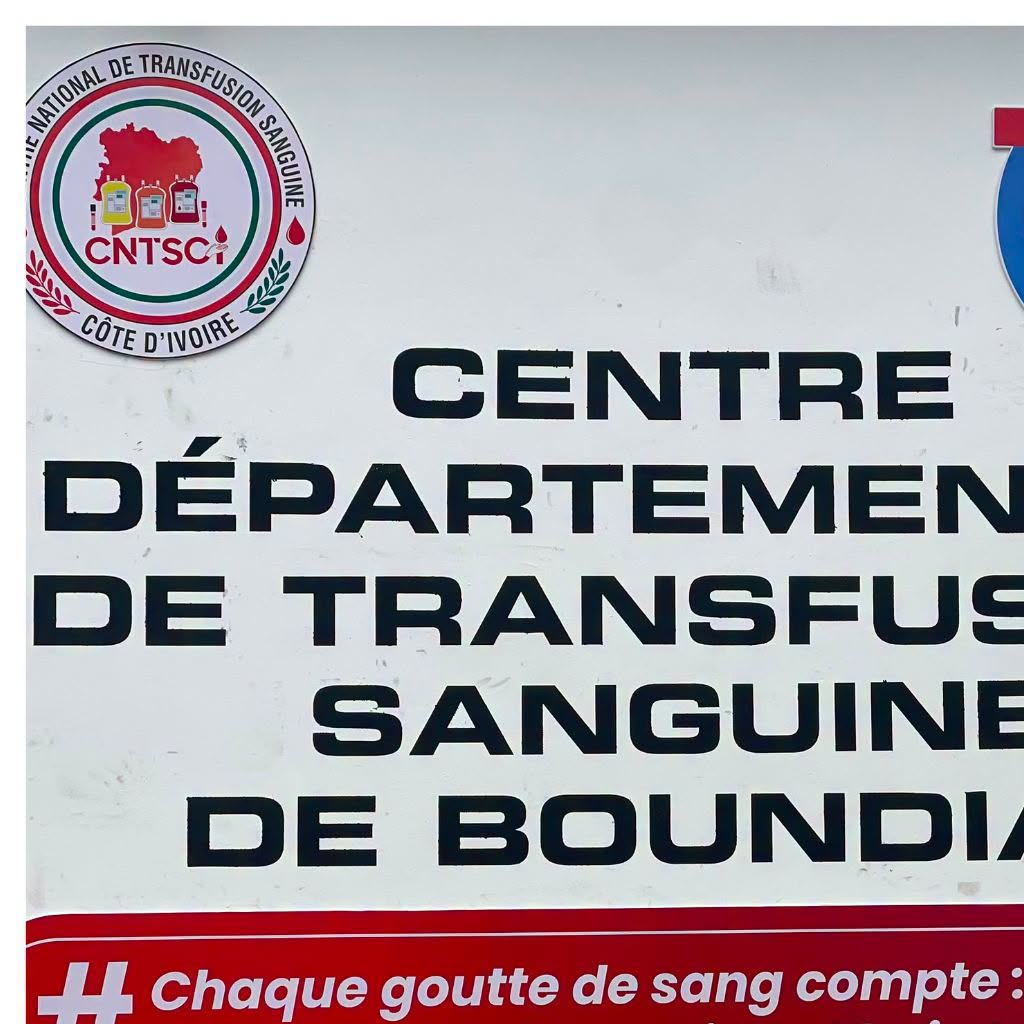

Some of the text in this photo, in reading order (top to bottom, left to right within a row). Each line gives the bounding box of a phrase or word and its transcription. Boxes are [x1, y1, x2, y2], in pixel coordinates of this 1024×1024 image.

[27, 54, 304, 208] NATIONAL DE TRANSFUSION SANGUINE
[81, 312, 239, 353] CÔTE D'IVOIRE
[393, 348, 953, 420] CENTRE
[34, 575, 226, 646] DE
[186, 796, 376, 867] DE
[152, 970, 367, 1022] Chaque
[380, 968, 559, 1021] goutte
[573, 965, 638, 1004] de
[651, 972, 783, 1016] sang
[797, 963, 999, 1013] compte
